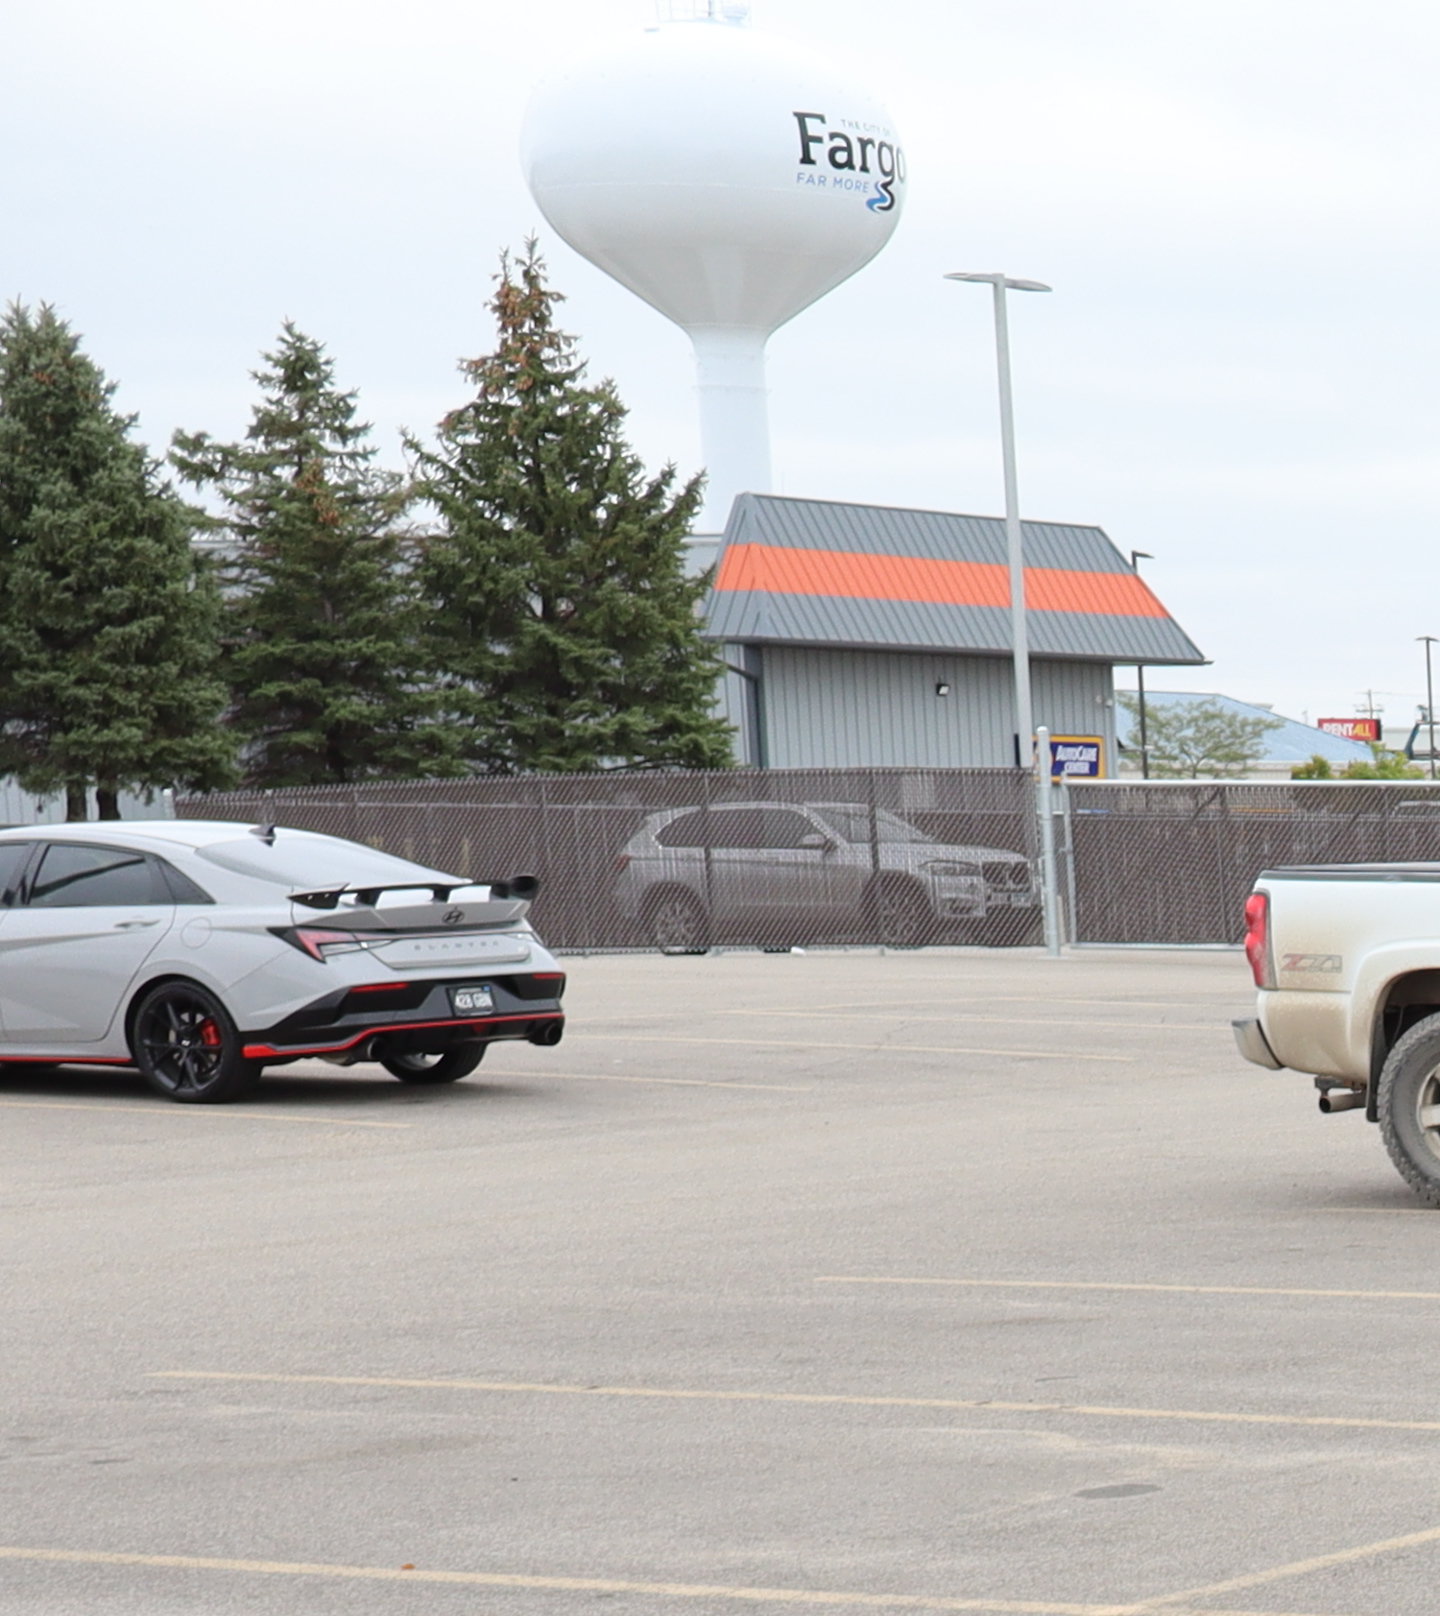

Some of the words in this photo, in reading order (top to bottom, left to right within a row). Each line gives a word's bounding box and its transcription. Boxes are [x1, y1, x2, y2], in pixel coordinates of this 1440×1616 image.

[792, 111, 906, 211] Fargo
[796, 172, 827, 187] FAR
[833, 176, 870, 193] MORE
